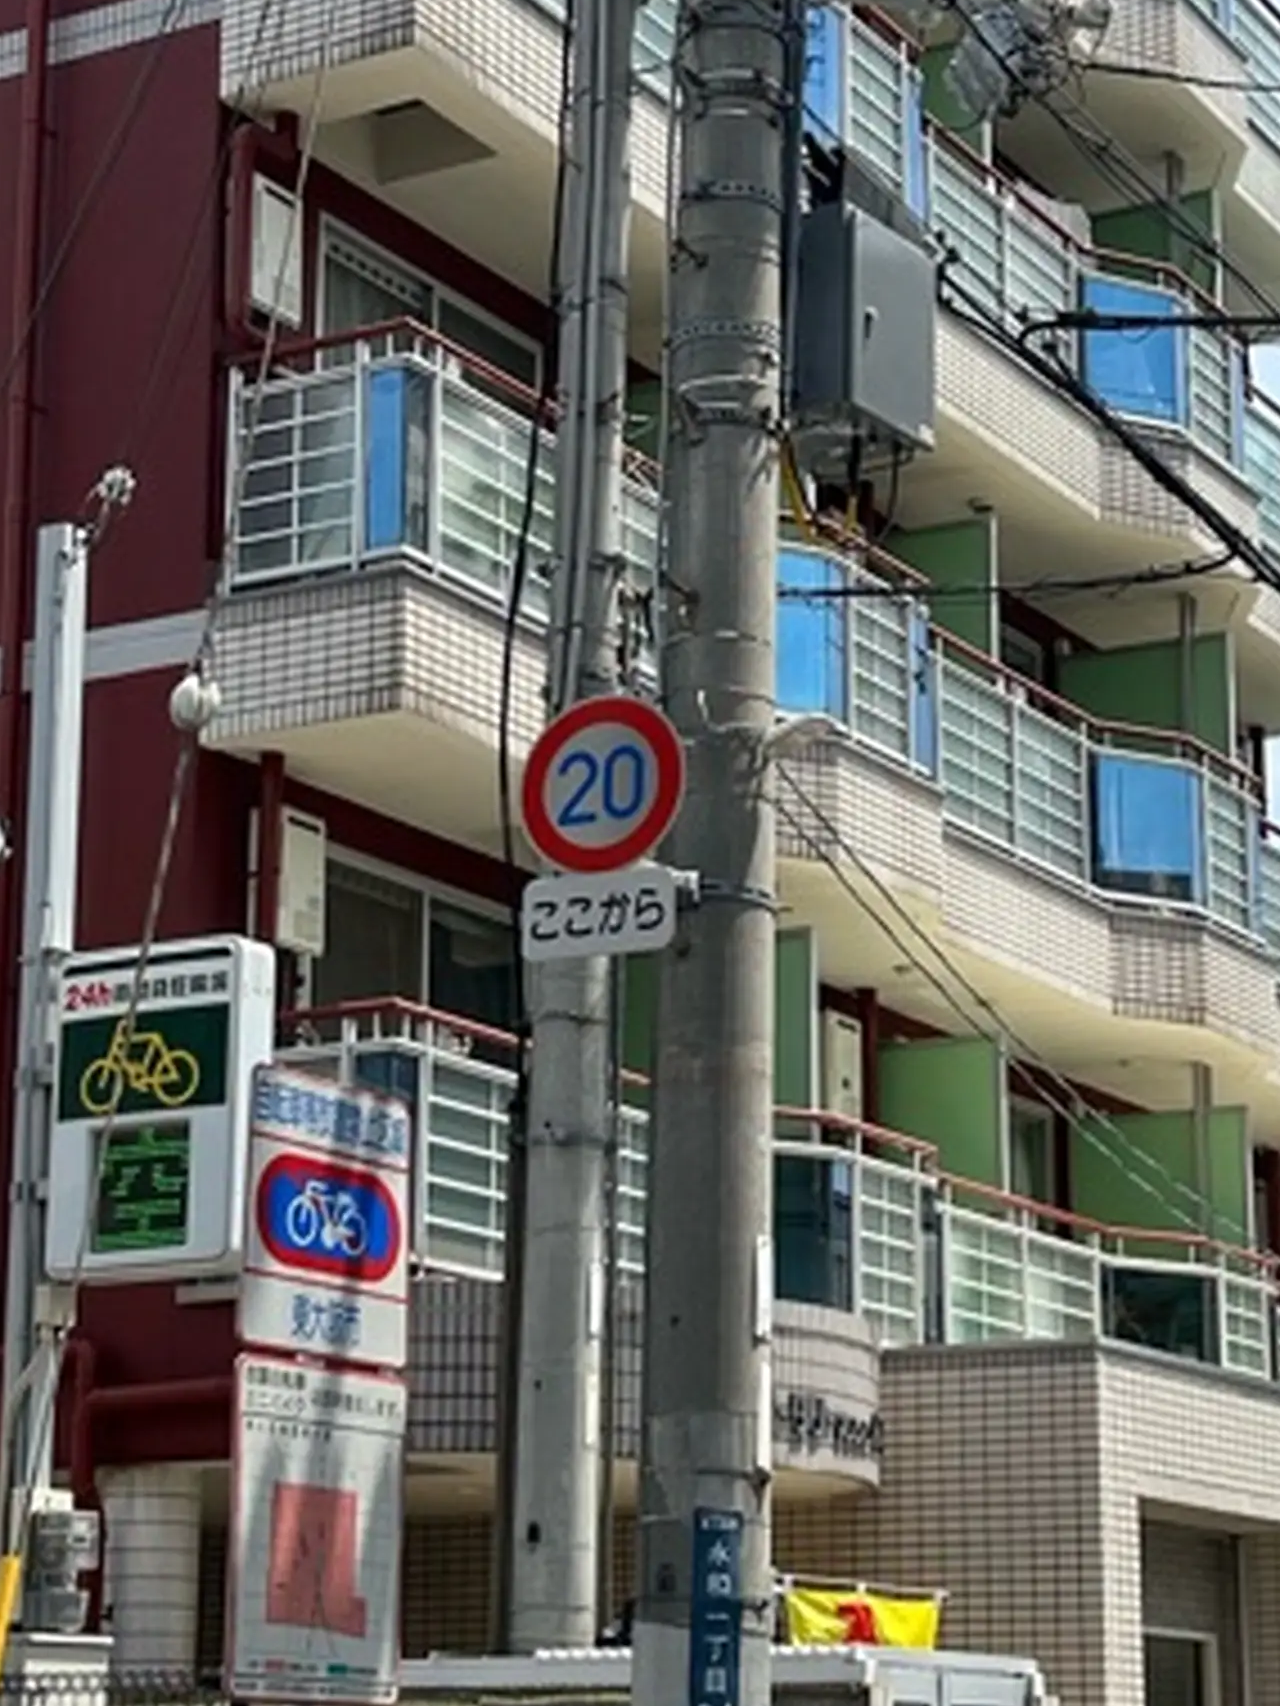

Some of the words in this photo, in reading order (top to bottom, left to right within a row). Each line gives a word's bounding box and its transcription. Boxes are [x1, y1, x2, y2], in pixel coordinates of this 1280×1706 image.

[557, 745, 645, 826] 20
[531, 889, 665, 941] ここから
